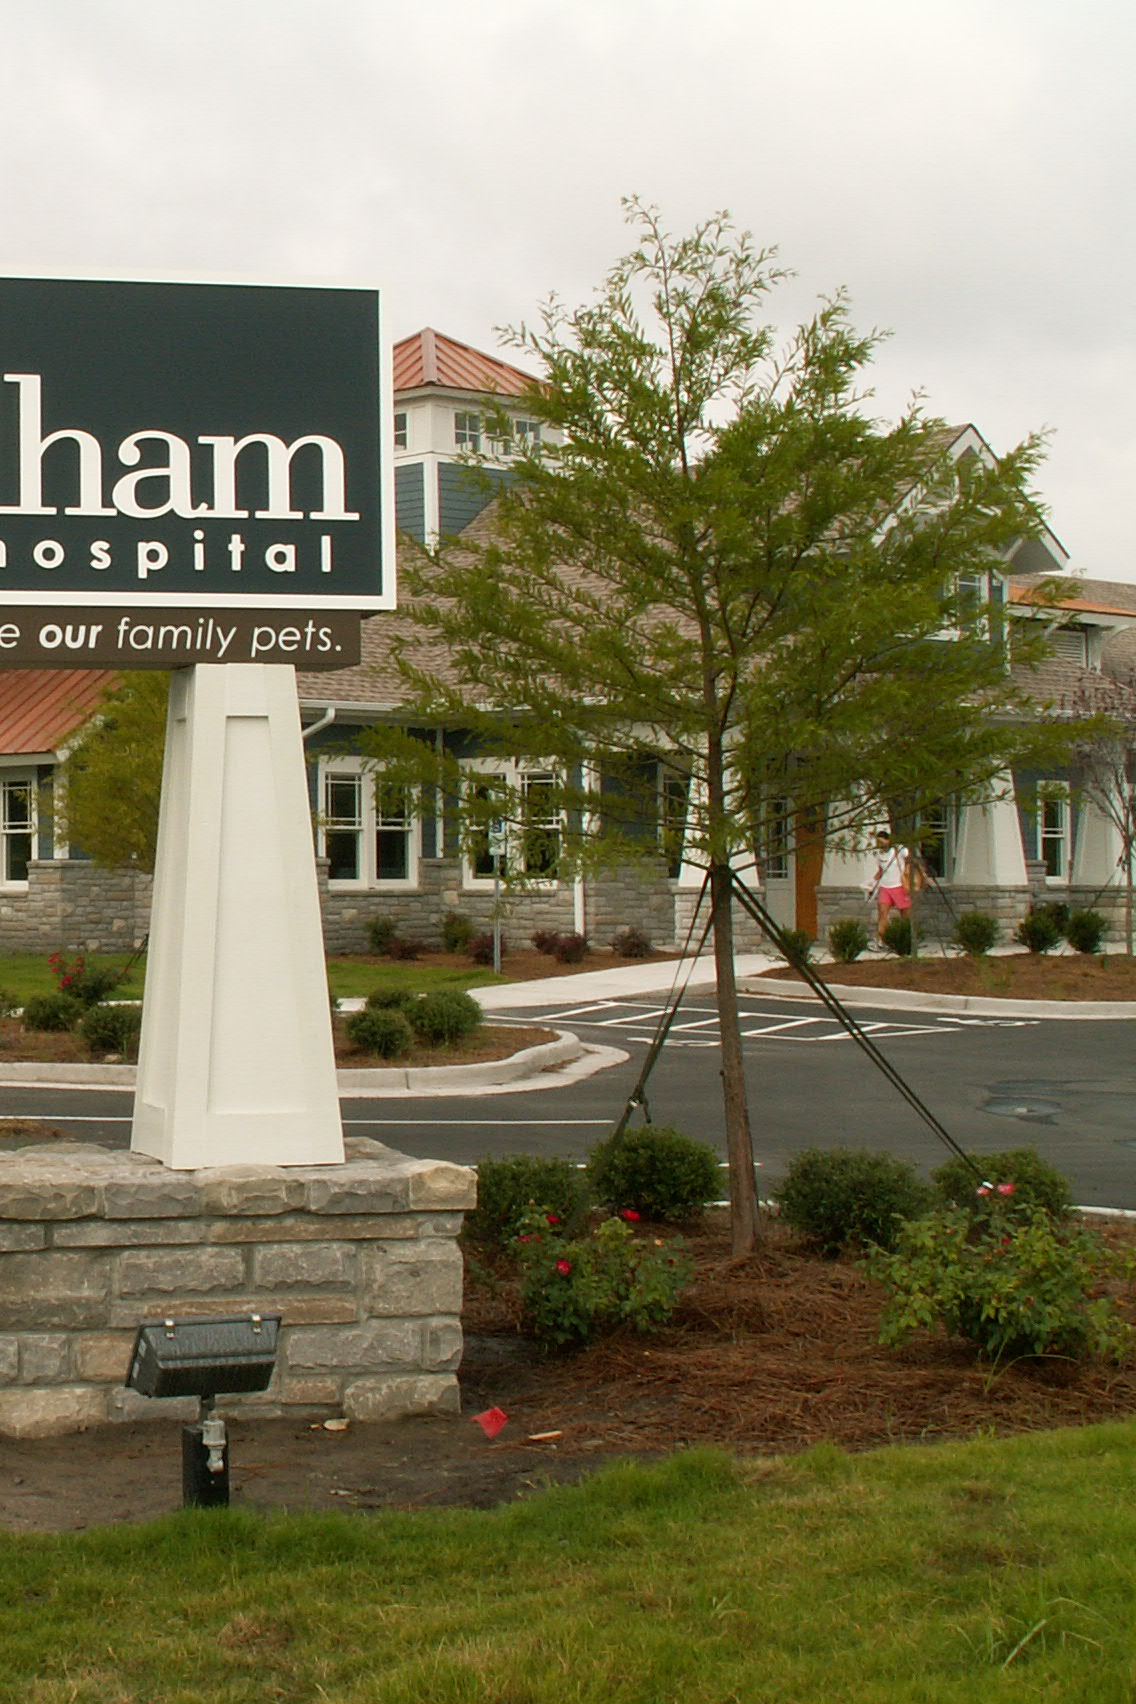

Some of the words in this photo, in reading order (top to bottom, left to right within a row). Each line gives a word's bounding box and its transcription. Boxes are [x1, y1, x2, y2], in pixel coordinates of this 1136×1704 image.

[38, 623, 105, 650] our
[117, 615, 238, 659] family
[250, 618, 344, 659] pets.
